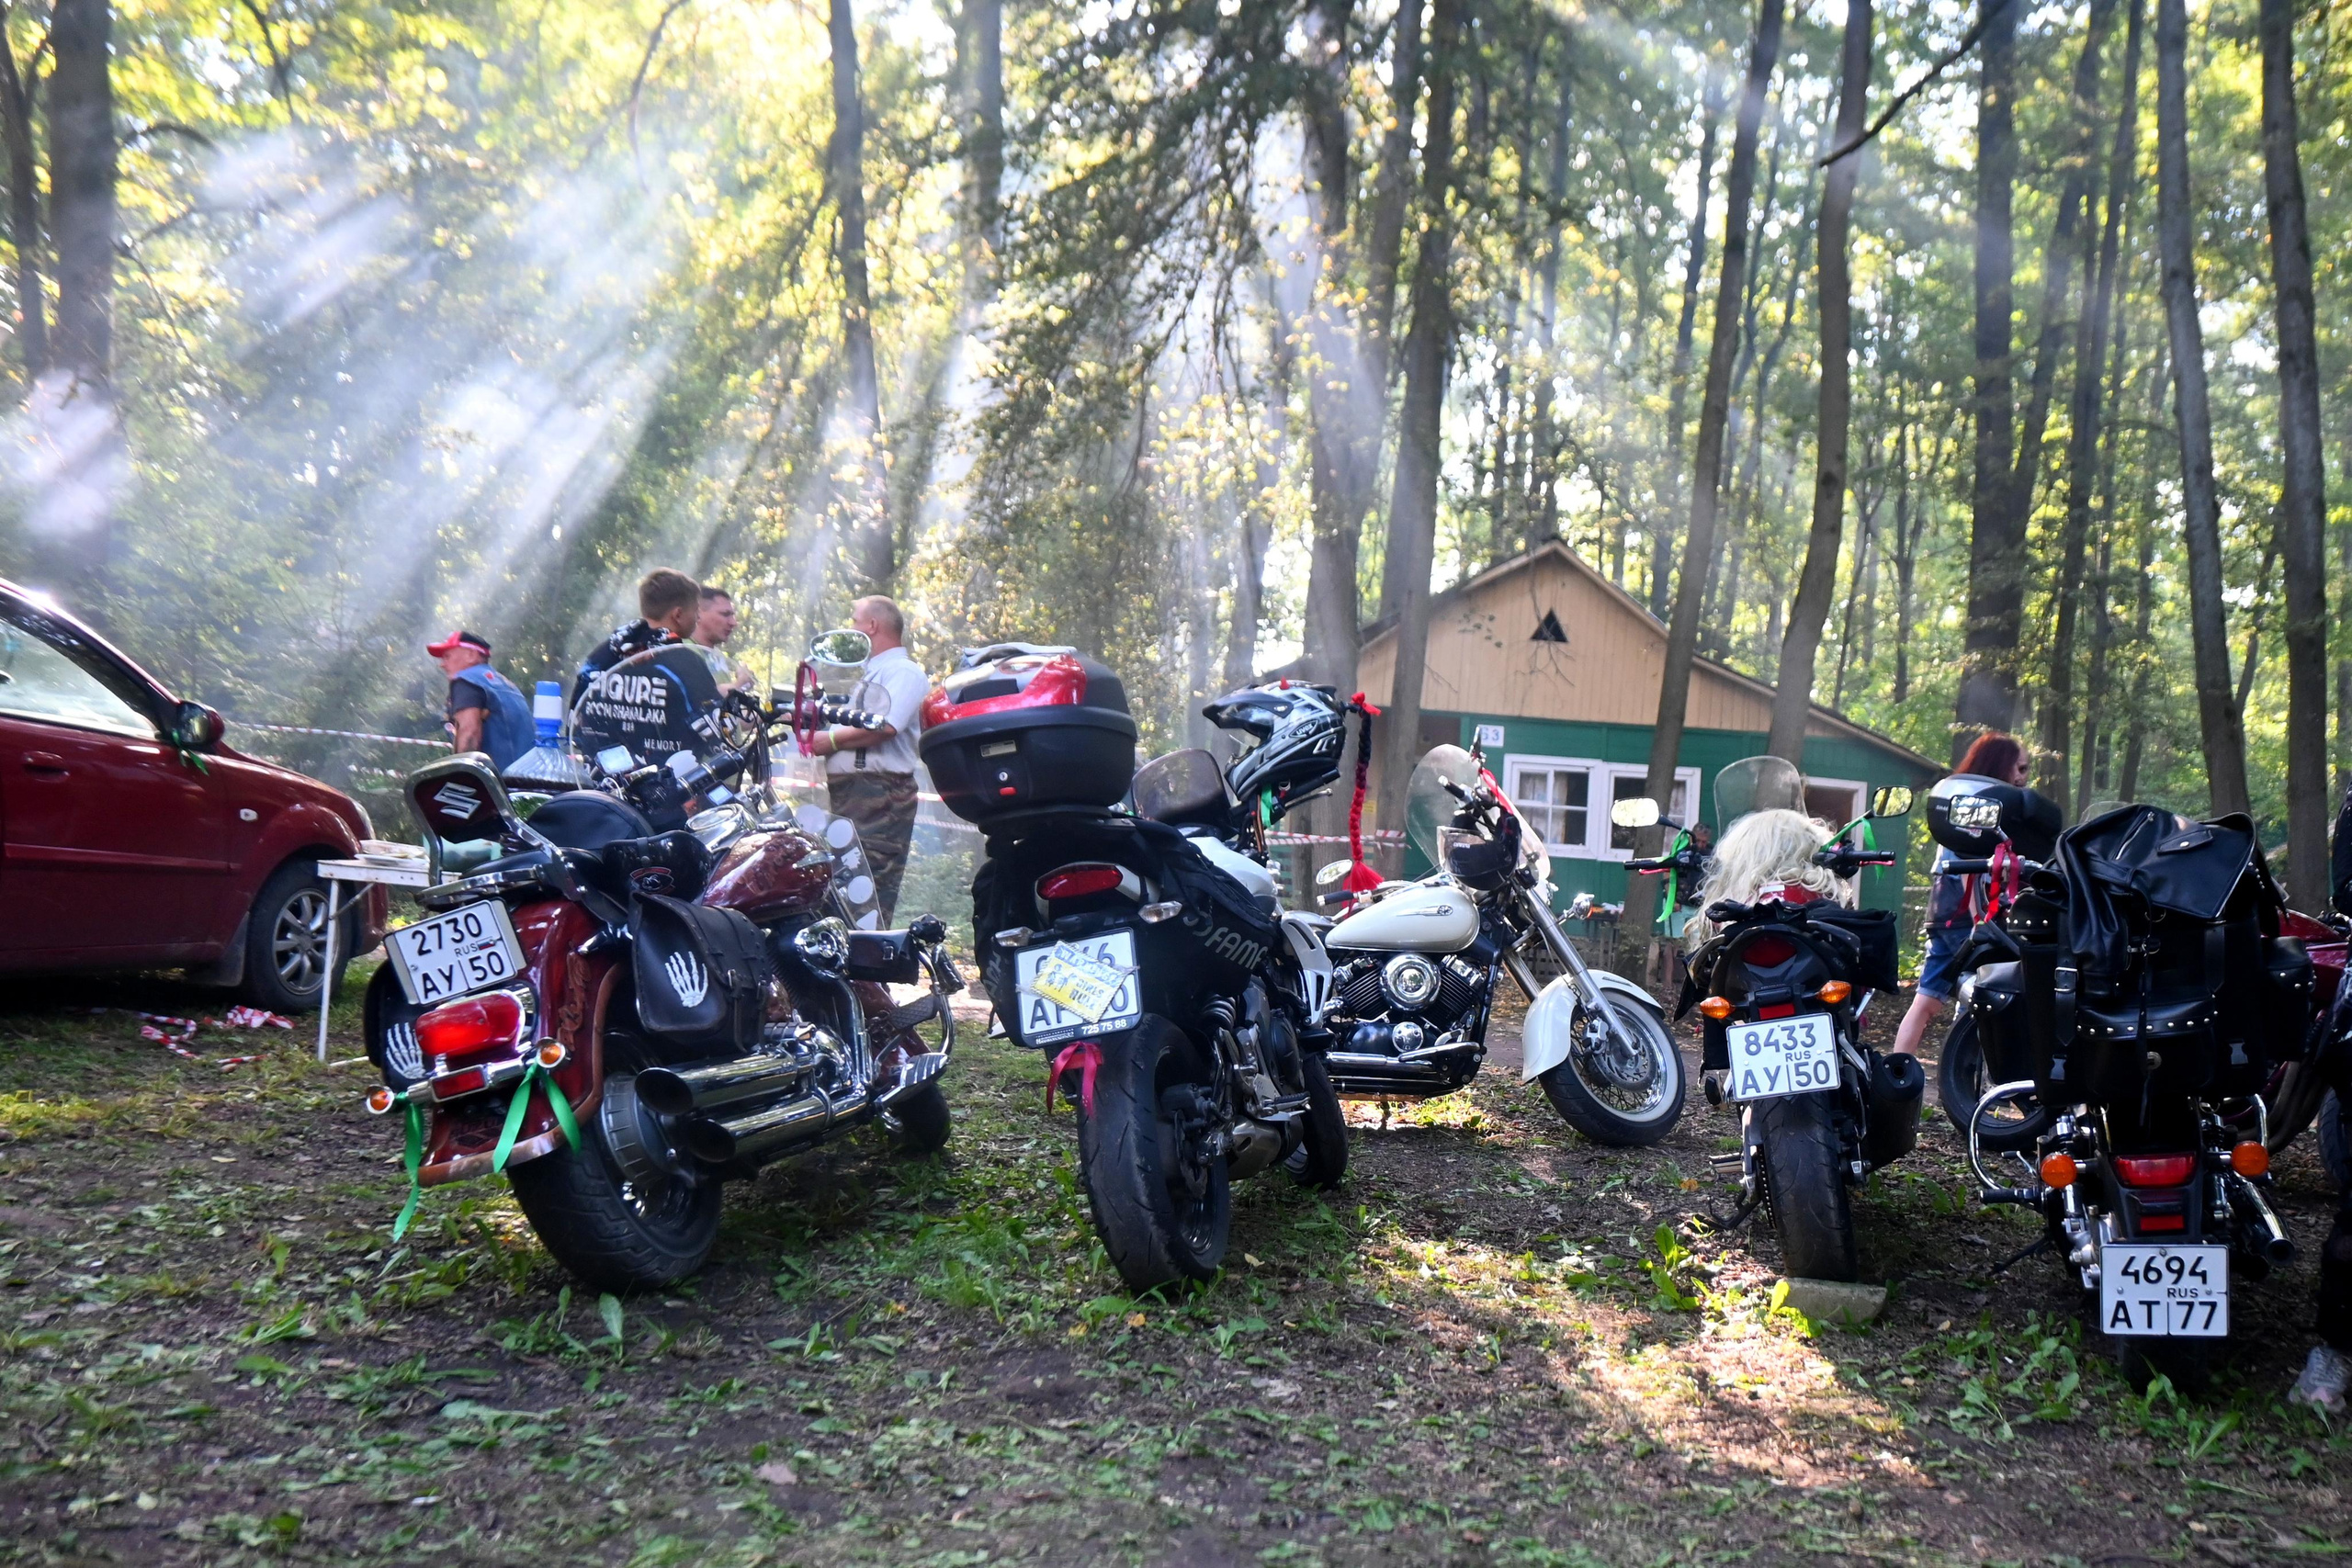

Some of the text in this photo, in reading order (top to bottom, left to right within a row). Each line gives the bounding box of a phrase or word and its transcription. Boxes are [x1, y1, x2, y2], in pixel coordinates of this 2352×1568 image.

[587, 670, 668, 707] FIGURE
[643, 738, 683, 751] MEMORY
[411, 912, 482, 956] 2730
[454, 942, 479, 957] RUS
[469, 951, 505, 982] 50
[1081, 1019, 1127, 1035] 725 75 88
[1744, 1022, 1816, 1056] 8433
[1785, 1050, 1811, 1062] RUS
[1793, 1059, 1830, 1087] 50
[2120, 1256, 2208, 1285] 4694
[2166, 1287, 2199, 1298] RUS
[2176, 1301, 2218, 1330] 77
